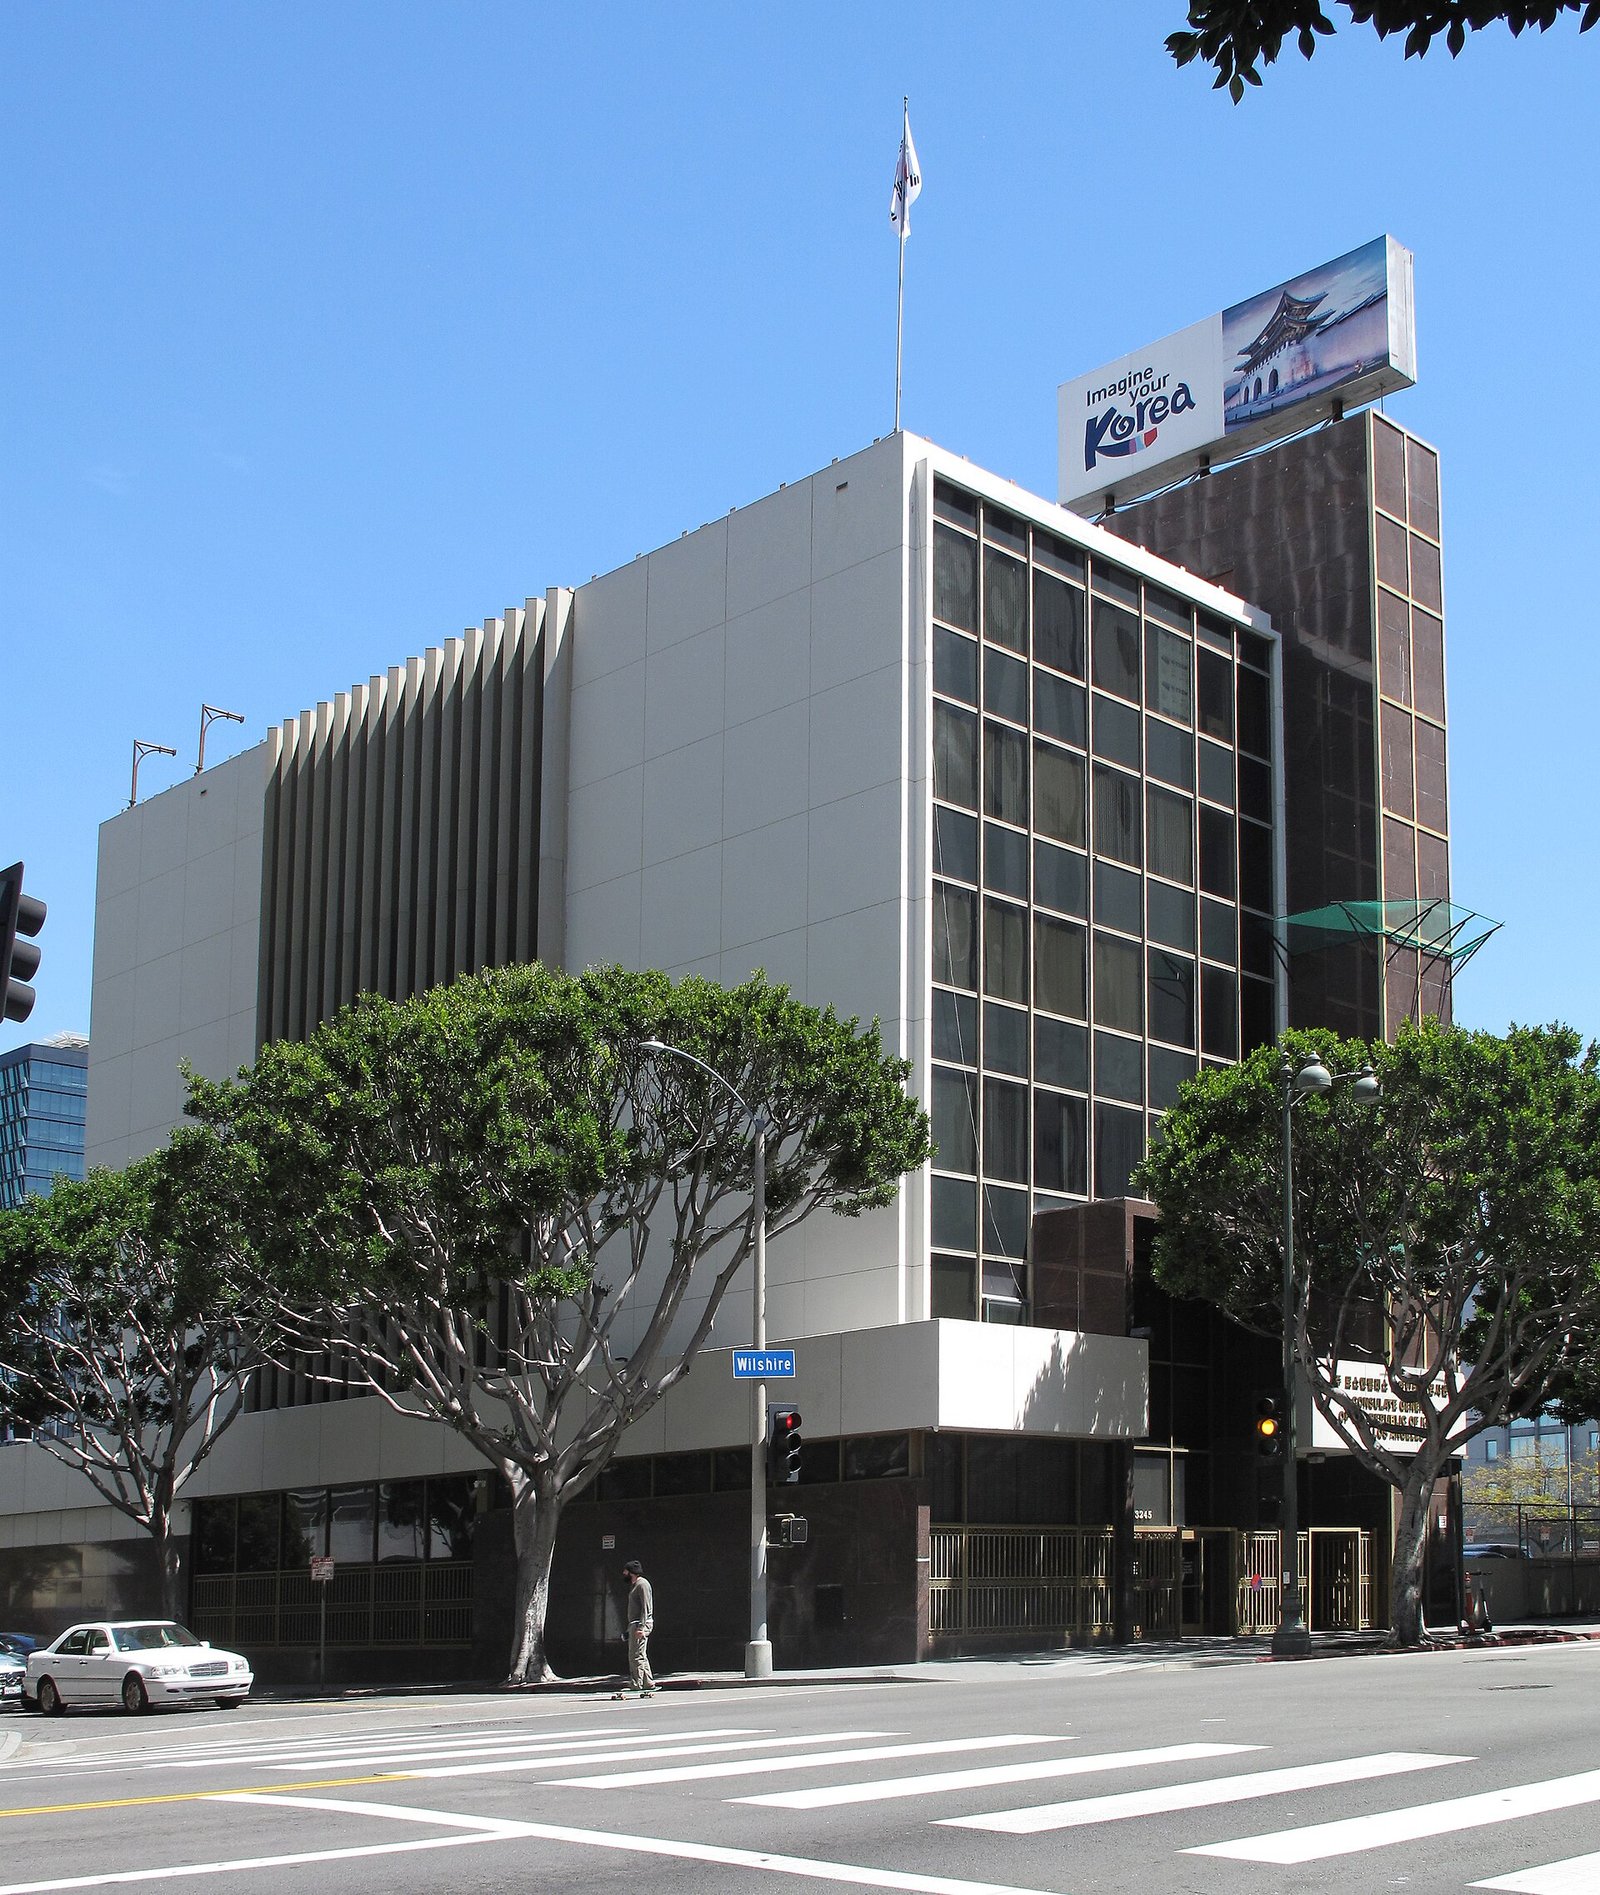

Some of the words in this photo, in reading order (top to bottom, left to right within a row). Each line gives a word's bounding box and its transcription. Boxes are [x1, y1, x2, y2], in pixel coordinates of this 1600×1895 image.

[1086, 367, 1153, 407] Imagine
[1129, 373, 1170, 407] your
[1085, 382, 1196, 472] Korea
[737, 1357, 791, 1371] Wilshire
[1352, 1396, 1397, 1412] CONSULATE
[1408, 1415, 1419, 1427] OF
